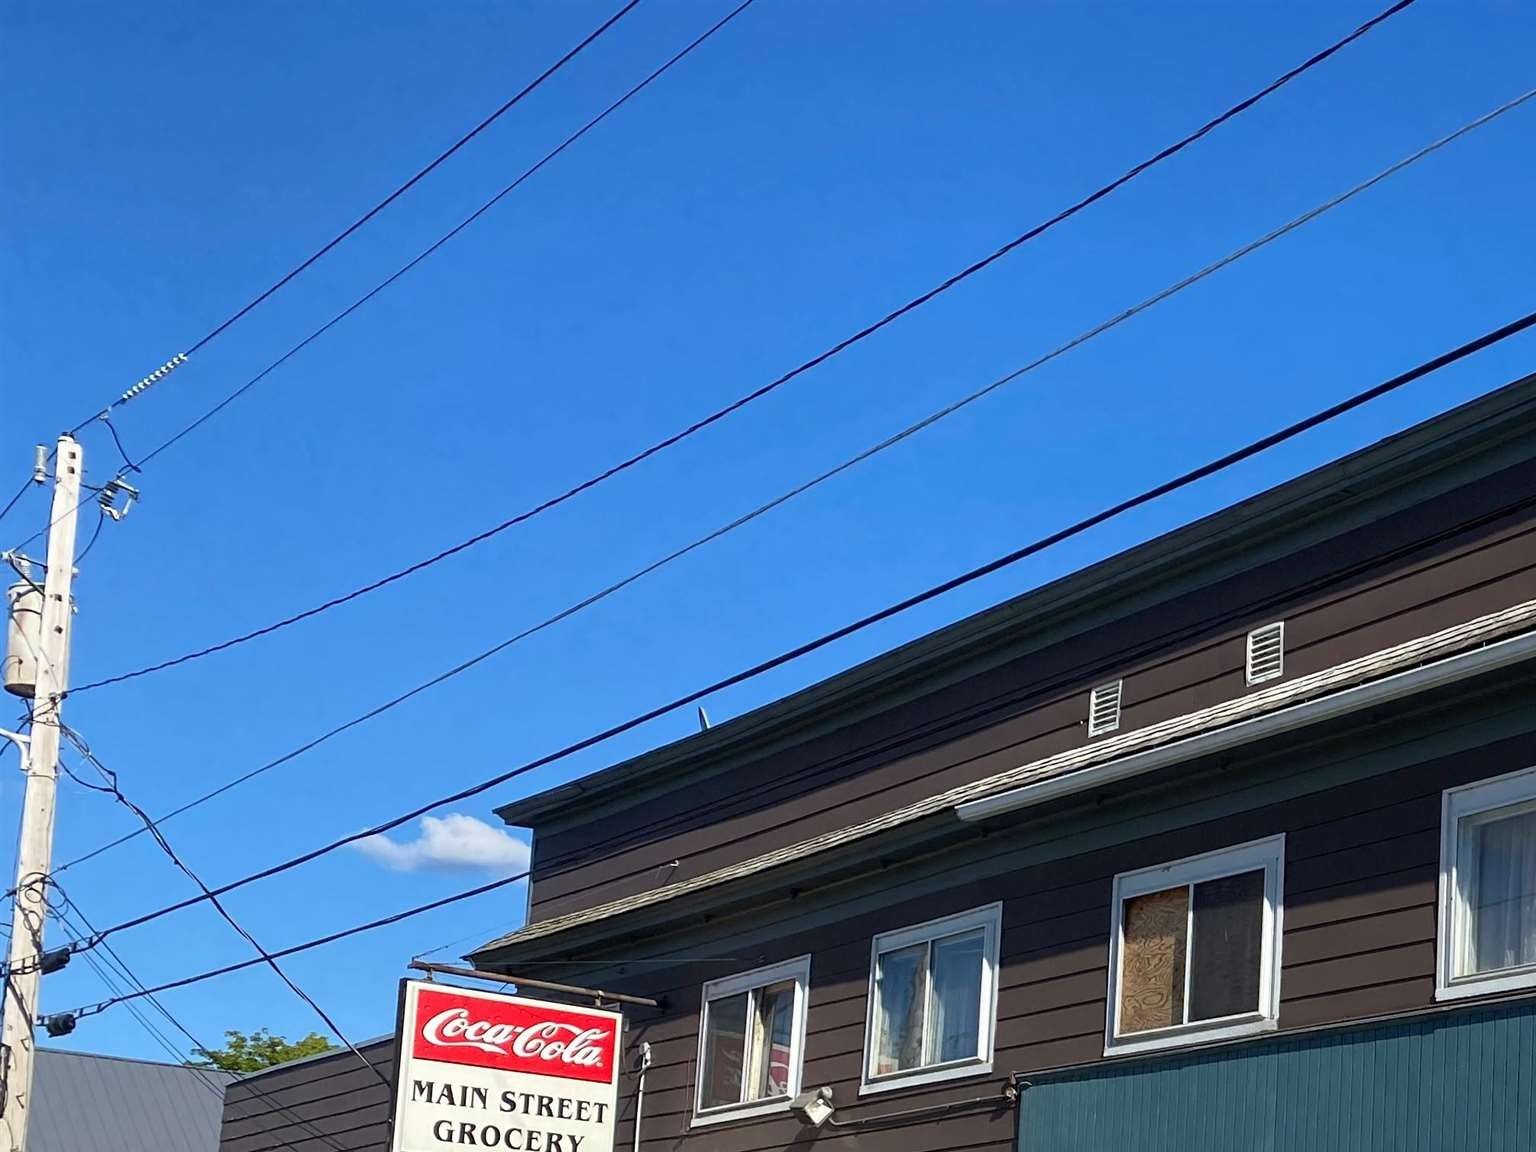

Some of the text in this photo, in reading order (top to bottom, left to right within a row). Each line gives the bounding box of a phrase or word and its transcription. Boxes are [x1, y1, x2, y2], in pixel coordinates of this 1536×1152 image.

[422, 1008, 610, 1066] Coca-Cola
[411, 1080, 609, 1124] MAIN STREET
